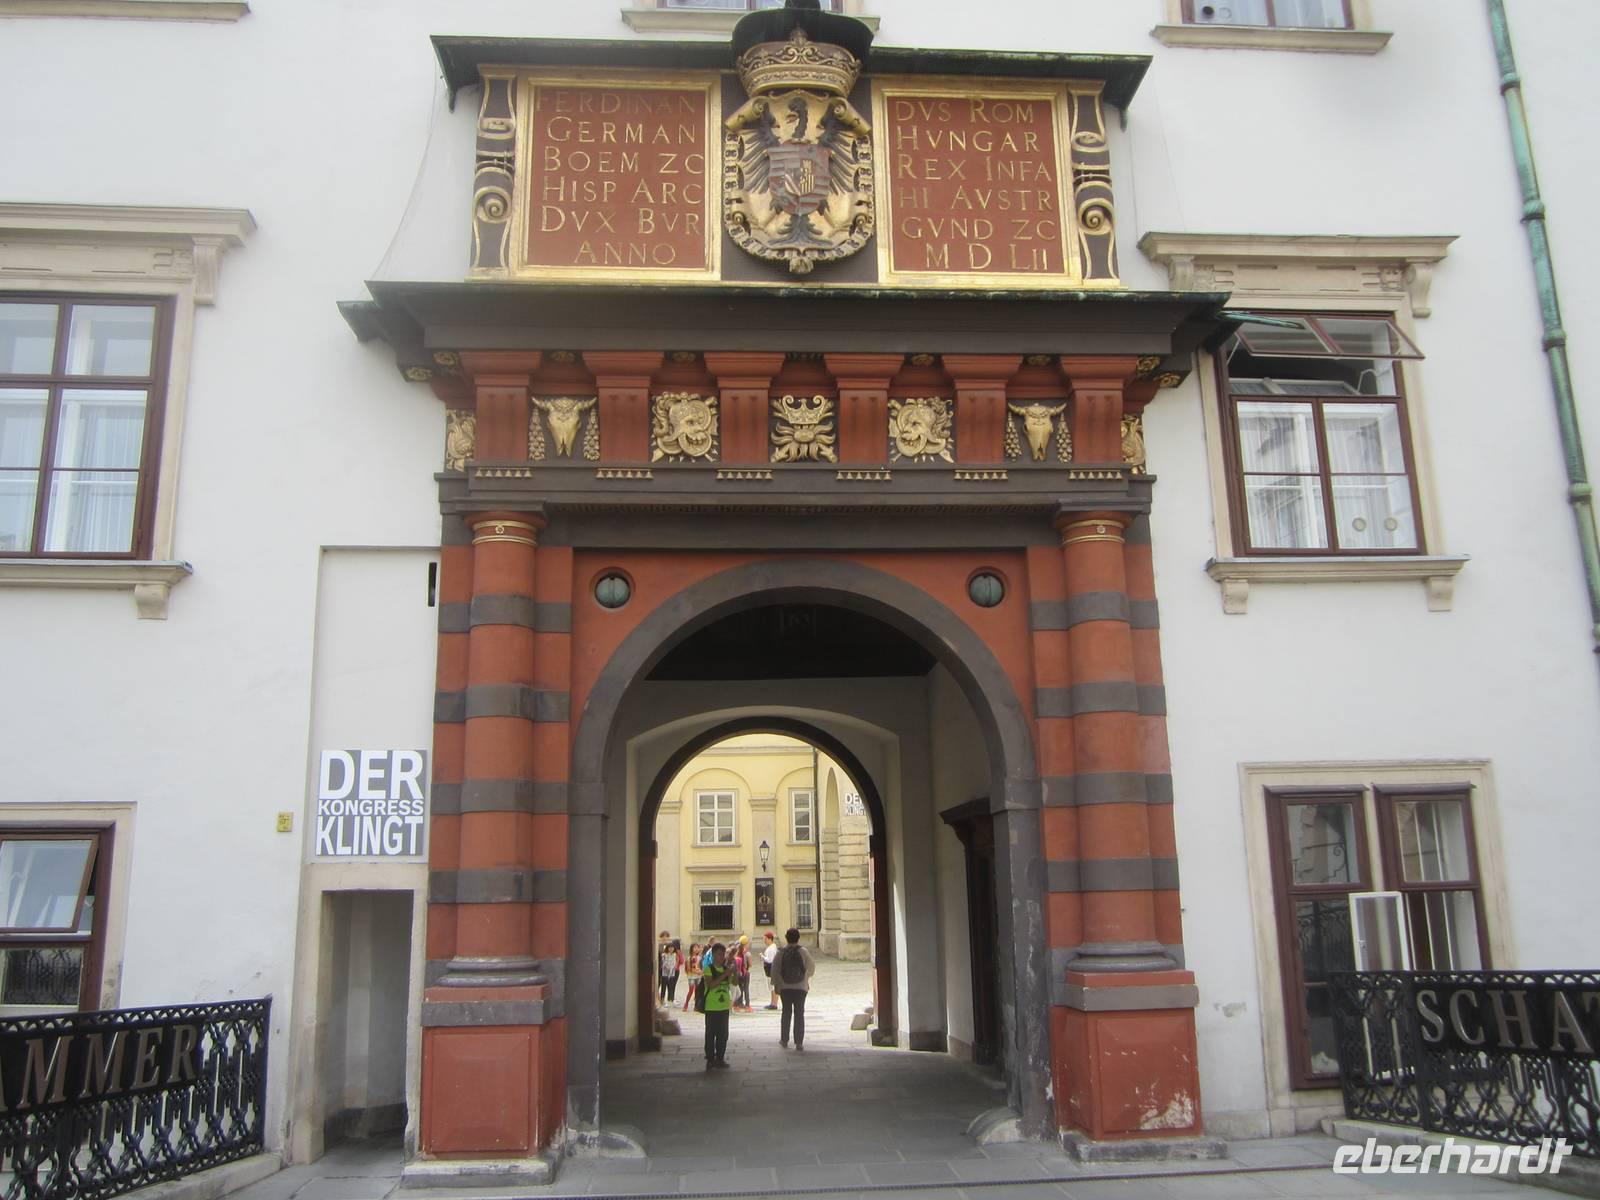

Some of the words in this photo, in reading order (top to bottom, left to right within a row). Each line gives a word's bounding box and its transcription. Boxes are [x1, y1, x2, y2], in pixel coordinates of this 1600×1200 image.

[895, 101, 951, 122] DVS
[969, 97, 1034, 124] ROM
[546, 116, 696, 145] GERMAN
[896, 125, 1040, 152] HVNGAR
[543, 145, 640, 173] BOEM
[897, 153, 966, 180] REX
[986, 156, 1052, 182] INFA
[543, 175, 617, 202] HISP
[631, 178, 702, 204] ARC
[899, 187, 929, 209] HI
[951, 185, 1052, 211] AVSTR
[540, 205, 616, 233] DVX
[637, 207, 700, 235] BVR
[902, 216, 994, 240] GVND
[574, 240, 676, 265] ANNO
[1009, 243, 1048, 271] LII
[319, 750, 424, 800] DER
[318, 800, 424, 816] KONGRESS
[315, 815, 423, 855] KLINGT
[0, 1024, 197, 1112] MMER
